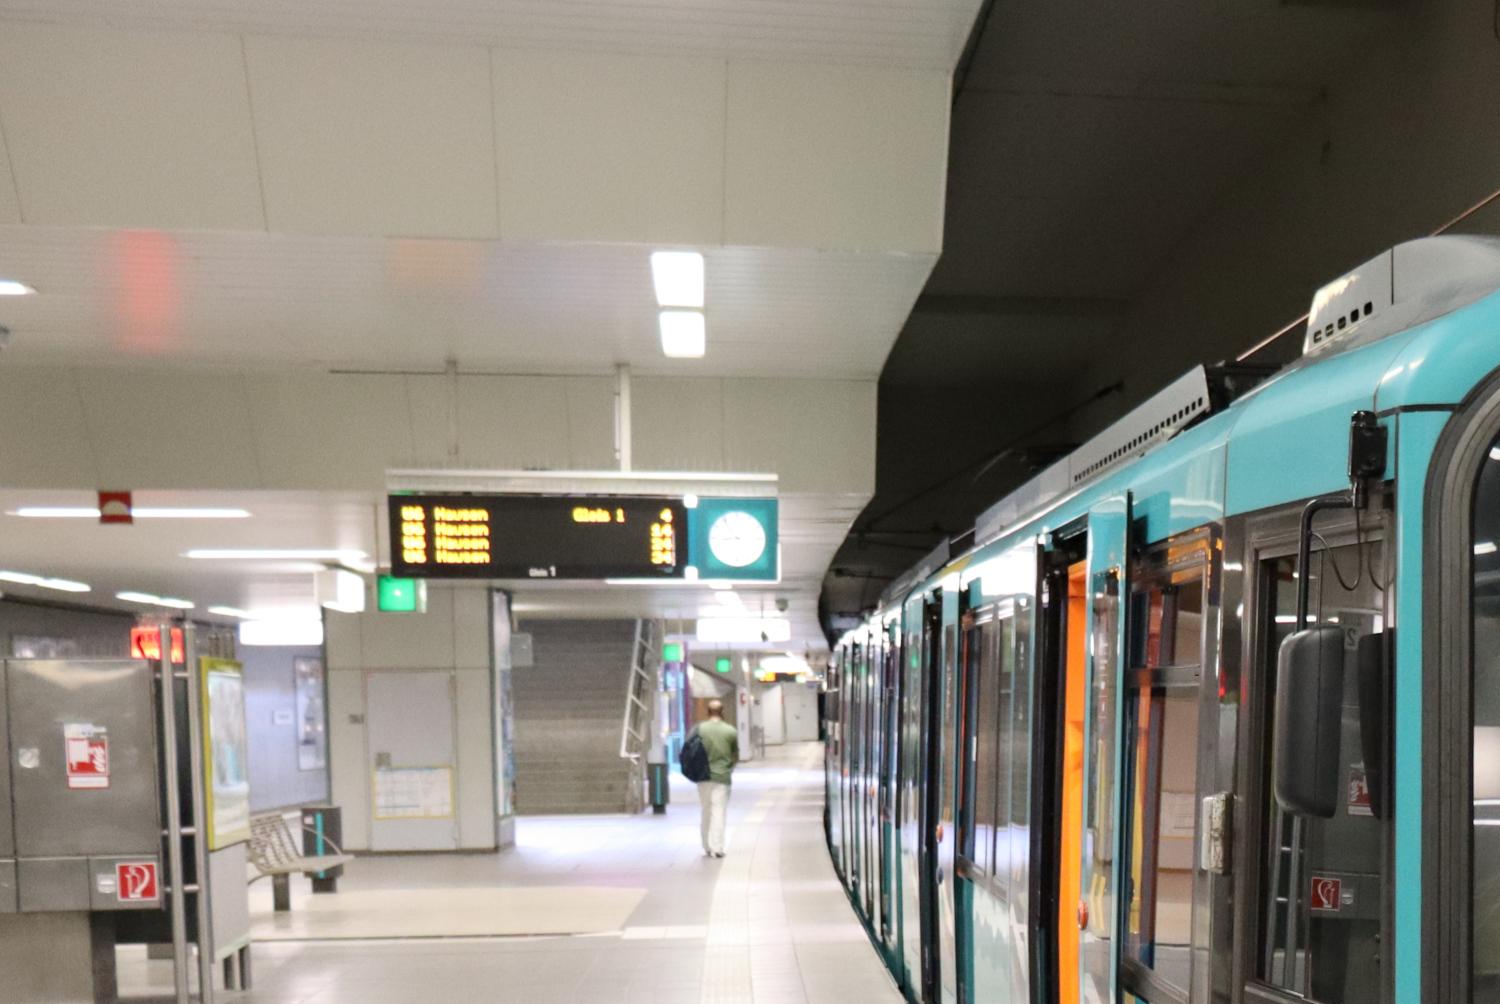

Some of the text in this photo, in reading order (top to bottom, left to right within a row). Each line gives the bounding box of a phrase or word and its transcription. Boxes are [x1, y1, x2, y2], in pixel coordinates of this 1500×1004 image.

[435, 508, 488, 521] Hausen
[435, 522, 489, 536] Hausen
[436, 535, 489, 550] Hausen
[436, 549, 490, 563] Hausen
